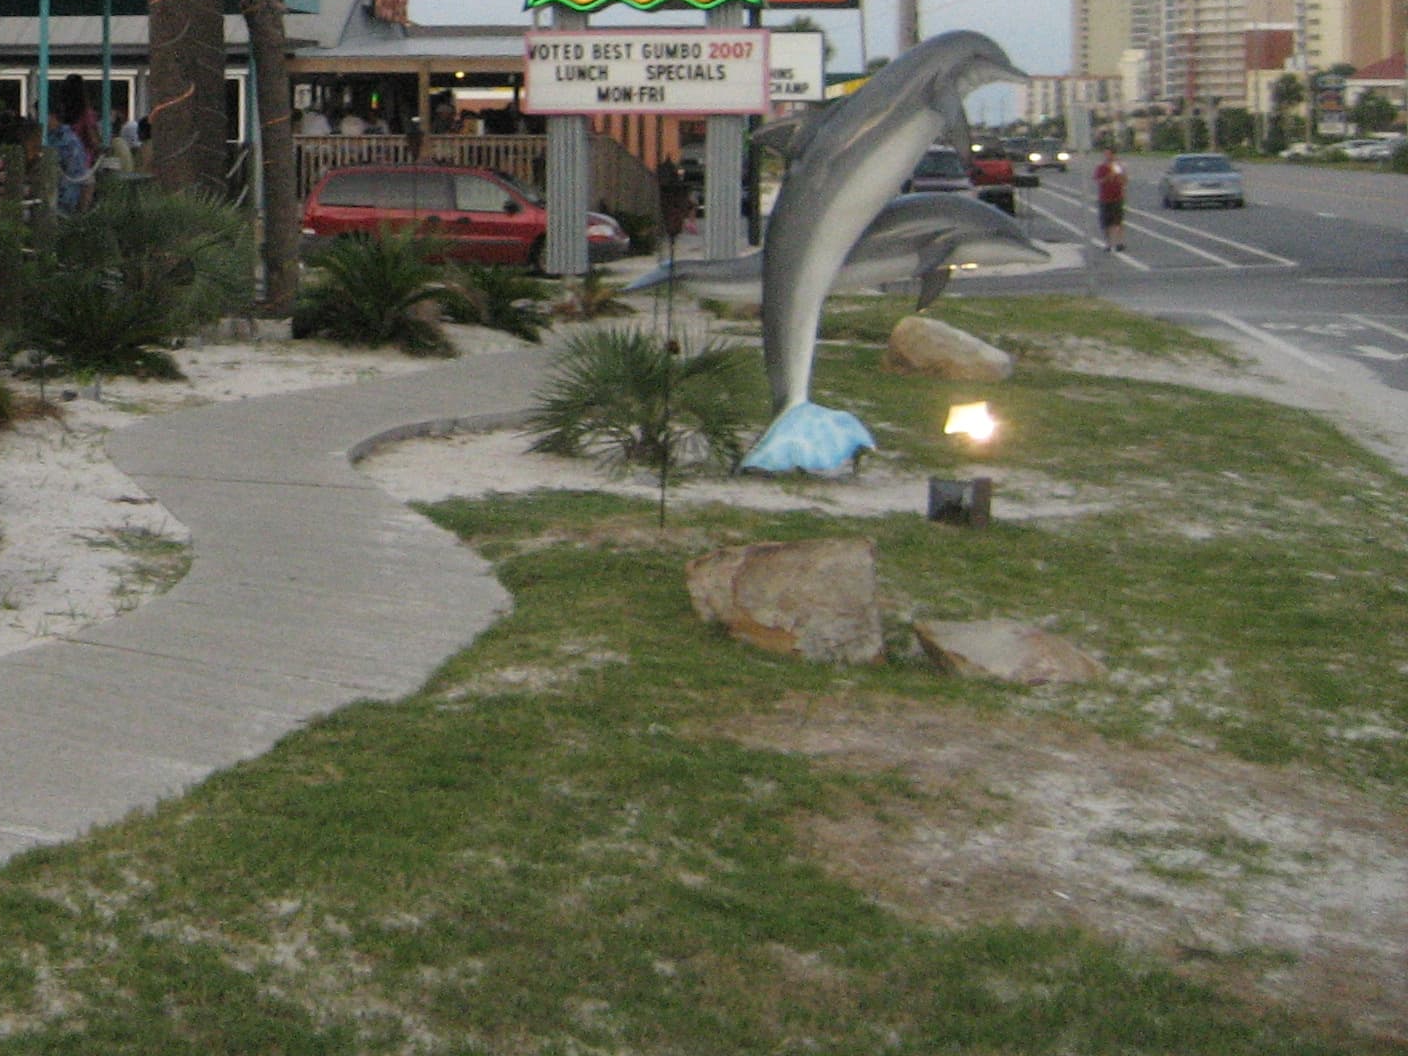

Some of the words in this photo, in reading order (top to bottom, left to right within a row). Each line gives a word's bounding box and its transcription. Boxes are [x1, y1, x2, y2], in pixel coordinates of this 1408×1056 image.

[528, 42, 585, 61] VOTED
[592, 42, 633, 60] BEST
[642, 42, 702, 59] GUMBO
[708, 41, 754, 59] 2007
[555, 64, 609, 82] LUNCH
[646, 64, 727, 81] SPECIALS
[596, 86, 665, 103] MON-FRI
